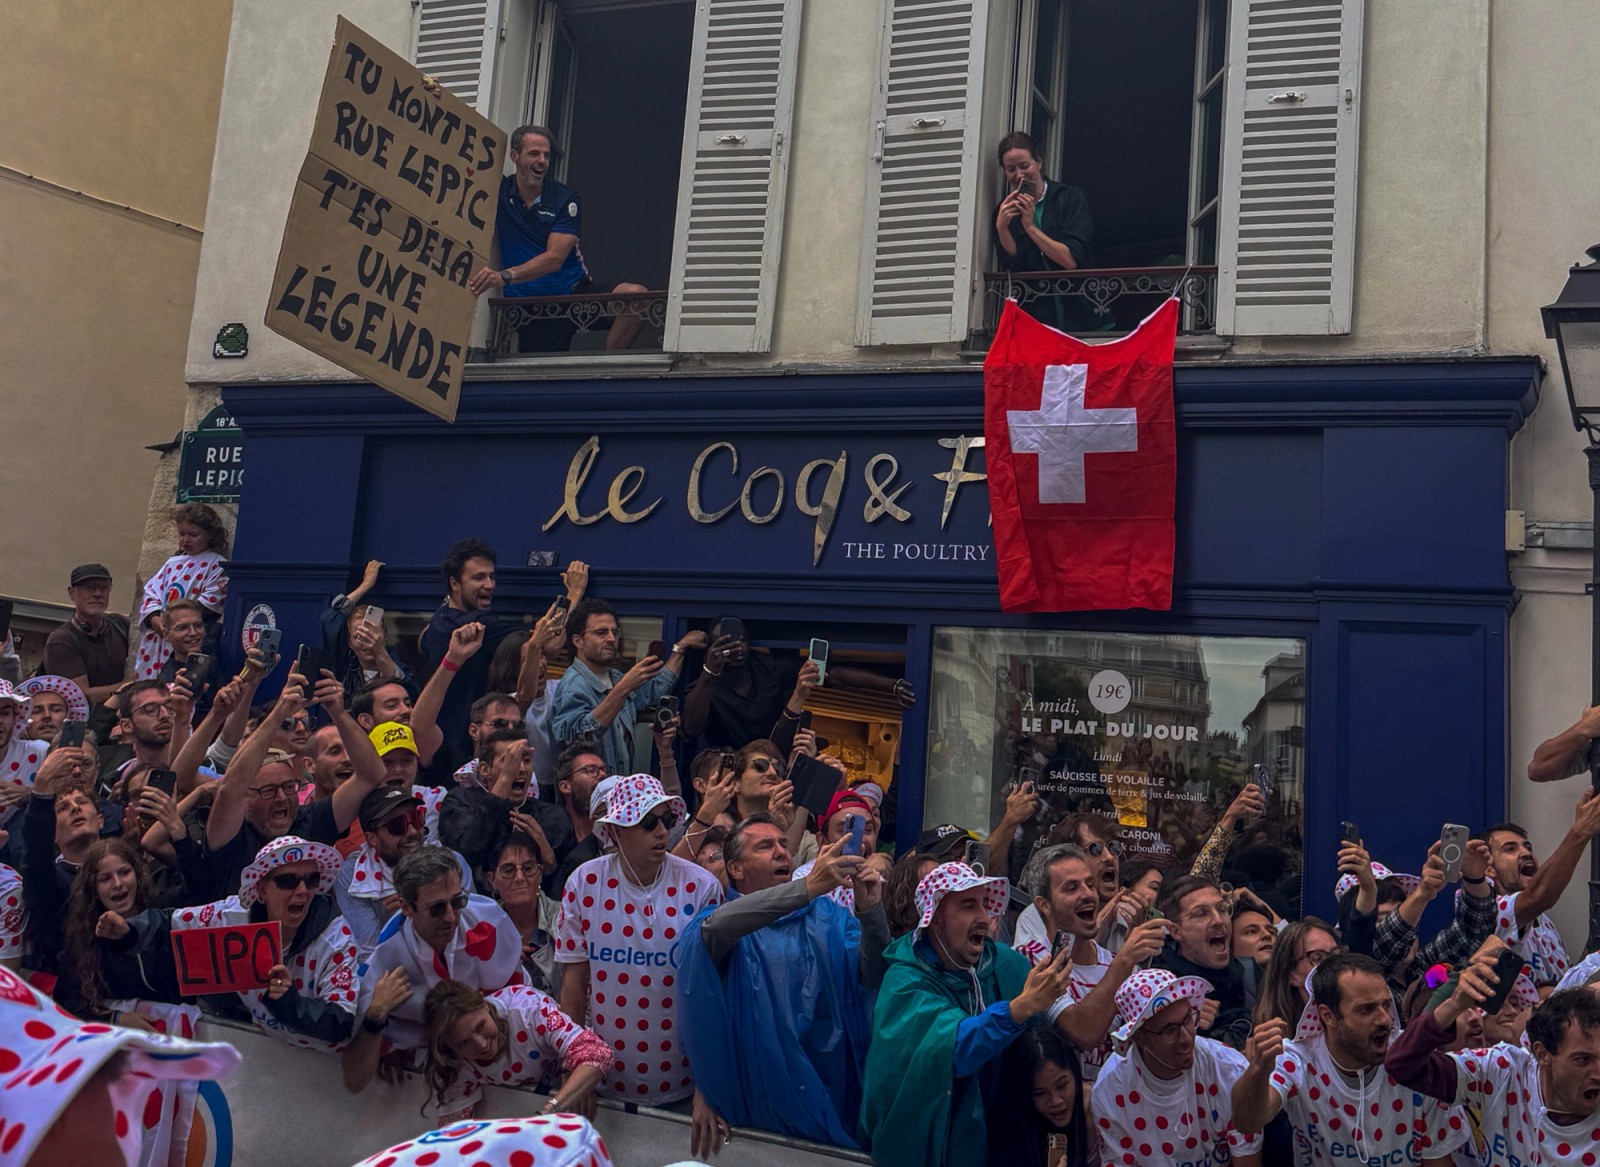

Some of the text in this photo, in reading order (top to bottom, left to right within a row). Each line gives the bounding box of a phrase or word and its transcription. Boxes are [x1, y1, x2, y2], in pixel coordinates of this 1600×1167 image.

[344, 42, 497, 172] TU MONTES
[333, 101, 490, 231] RUE LEPIC
[319, 168, 474, 289] T'ES DÉJÀ
[357, 244, 426, 315] UNE
[276, 264, 462, 402] LÉGENDE
[206, 446, 243, 463] RUE
[541, 434, 990, 567] le Coq & F
[843, 543, 990, 561] THE POULTRY
[1096, 684, 1125, 699] 19€
[1022, 692, 1080, 716] À midi,
[1021, 717, 1199, 741] LE PLAT DU JOUR
[1092, 750, 1123, 762] Lundi
[1049, 770, 1165, 786] SAUCISSE DE VOLAILLE
[1037, 783, 1055, 791] urée
[1057, 783, 1067, 792] de
[1069, 785, 1104, 795] pommes
[1106, 787, 1117, 795] de
[1118, 787, 1138, 797] terre
[1149, 788, 1162, 800] jus
[1164, 790, 1174, 799] de
[1176, 791, 1208, 802] volaille
[175, 928, 278, 985] LIPO
[589, 942, 667, 967] Leclerc
